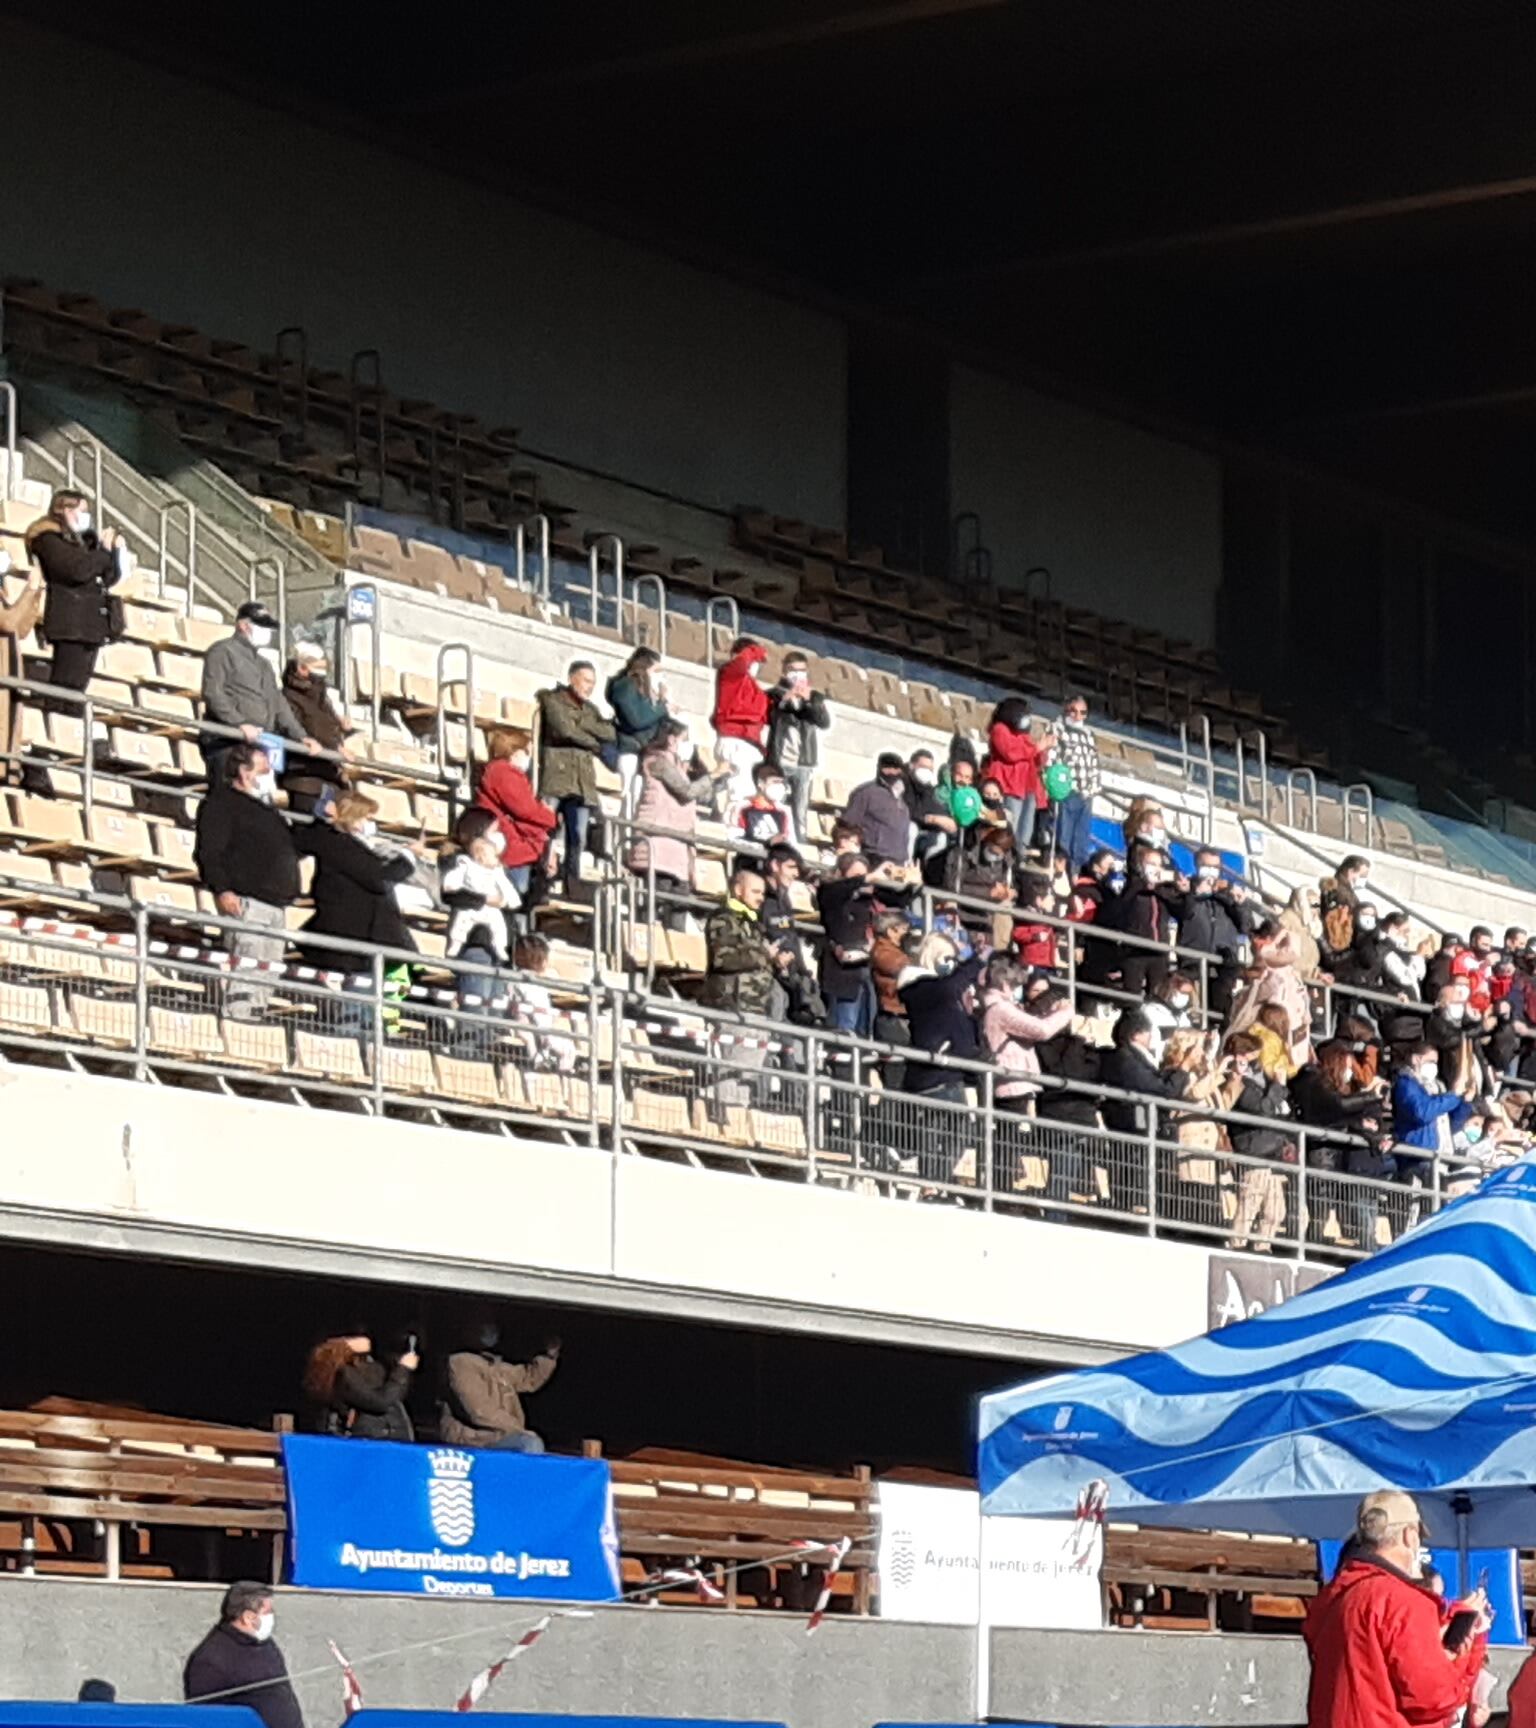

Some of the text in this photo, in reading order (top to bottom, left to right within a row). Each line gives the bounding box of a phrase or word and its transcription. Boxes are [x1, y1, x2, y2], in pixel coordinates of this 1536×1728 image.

[340, 1542, 570, 1580] Ayuntamiento de Jerez
